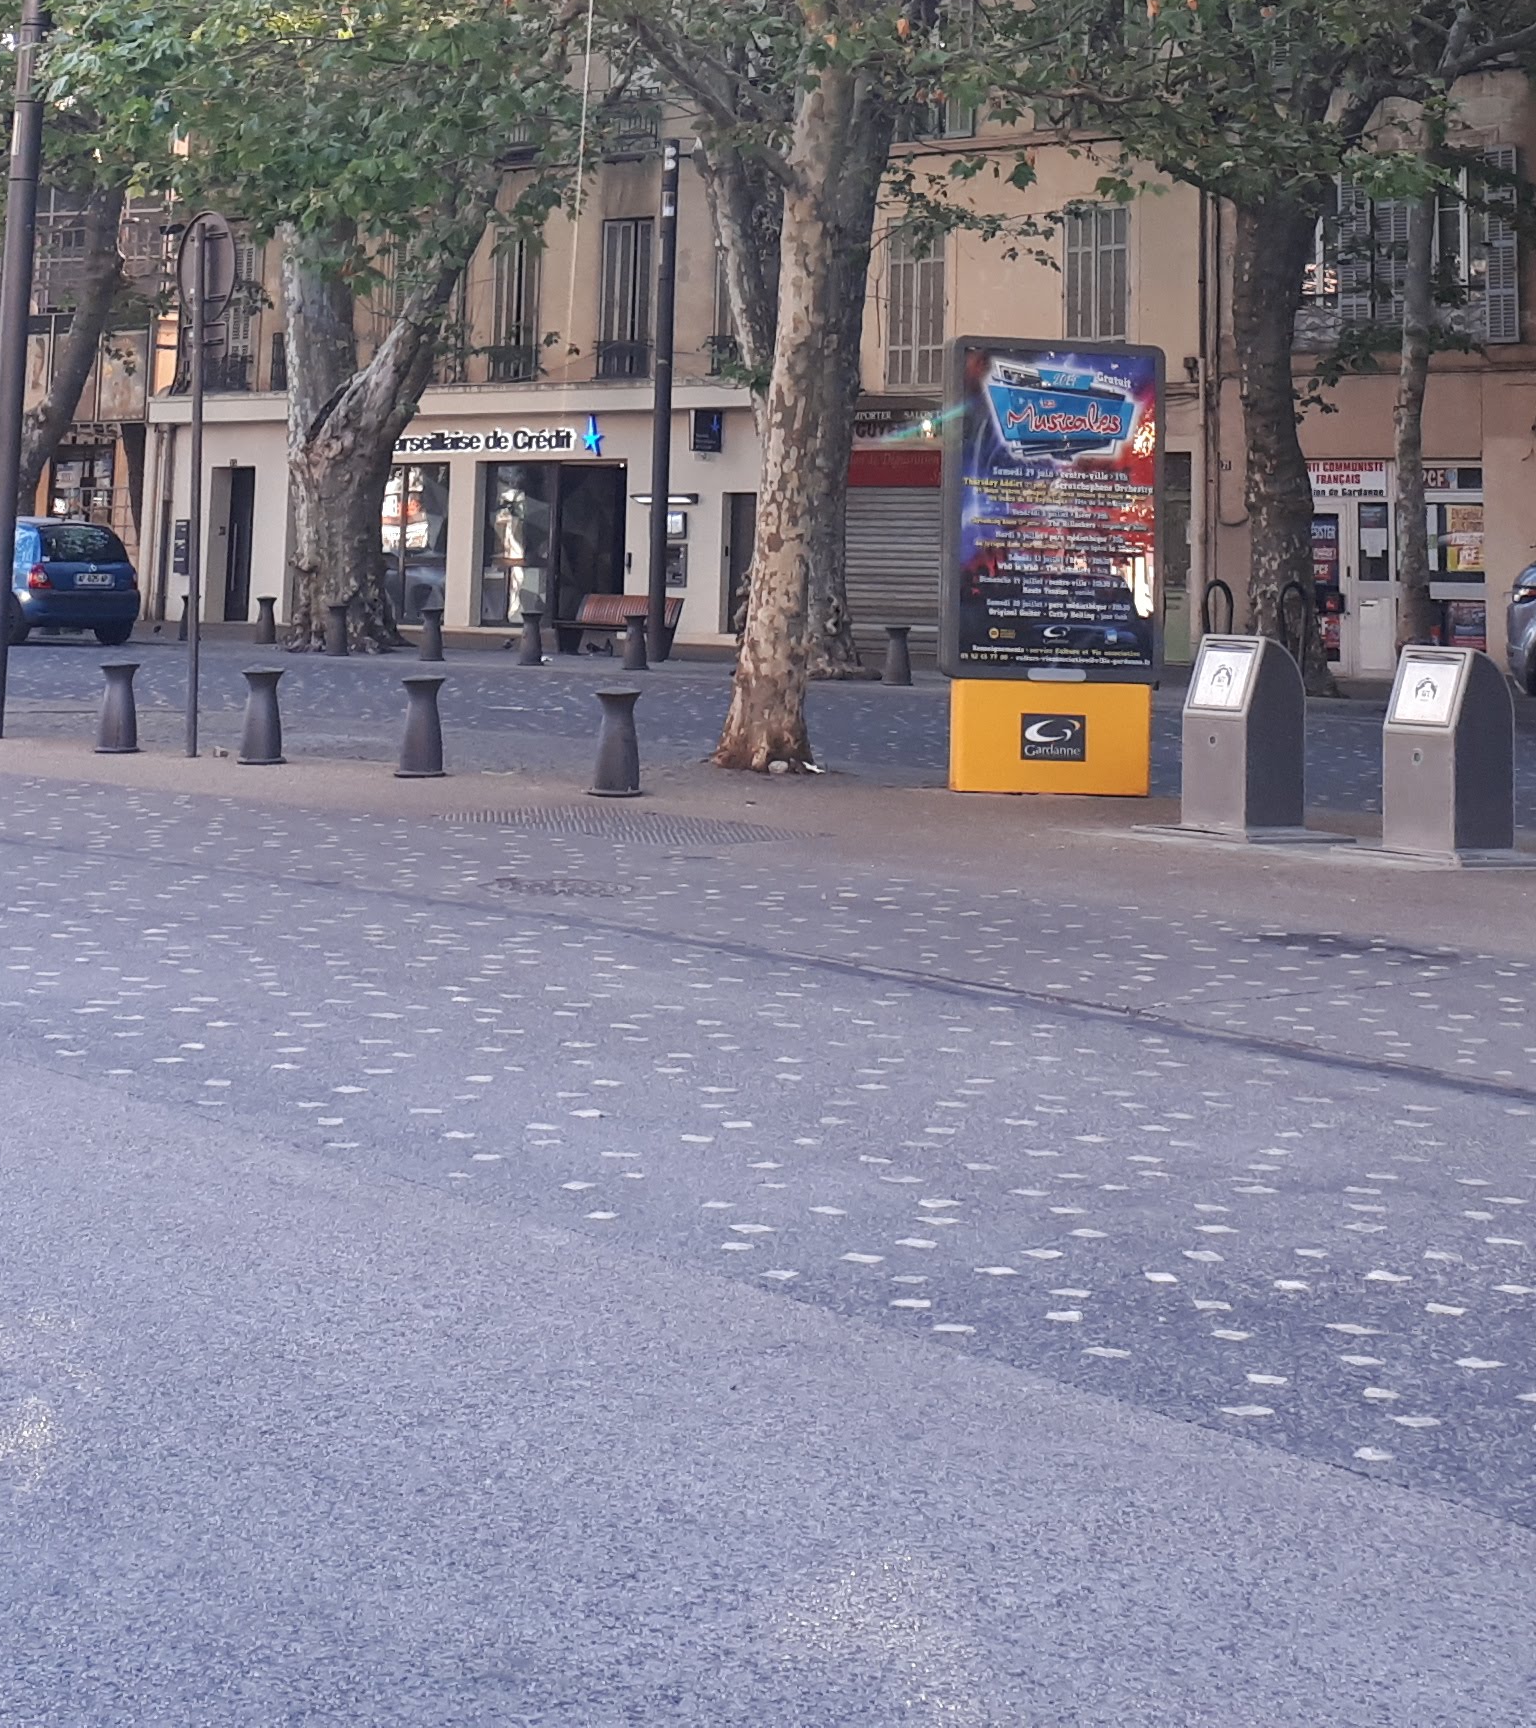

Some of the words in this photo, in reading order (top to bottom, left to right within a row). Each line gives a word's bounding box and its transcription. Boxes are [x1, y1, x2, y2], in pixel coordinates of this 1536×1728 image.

[1007, 401, 1123, 435] Musicales
[393, 431, 482, 453] arseillaise
[485, 430, 510, 451] de
[513, 429, 573, 451] Crédit
[1322, 462, 1384, 472] COMMUNISTE
[1316, 474, 1361, 486] FRANÇAIS
[1341, 488, 1384, 497] Gardanne
[1024, 743, 1081, 757] Gardanne
